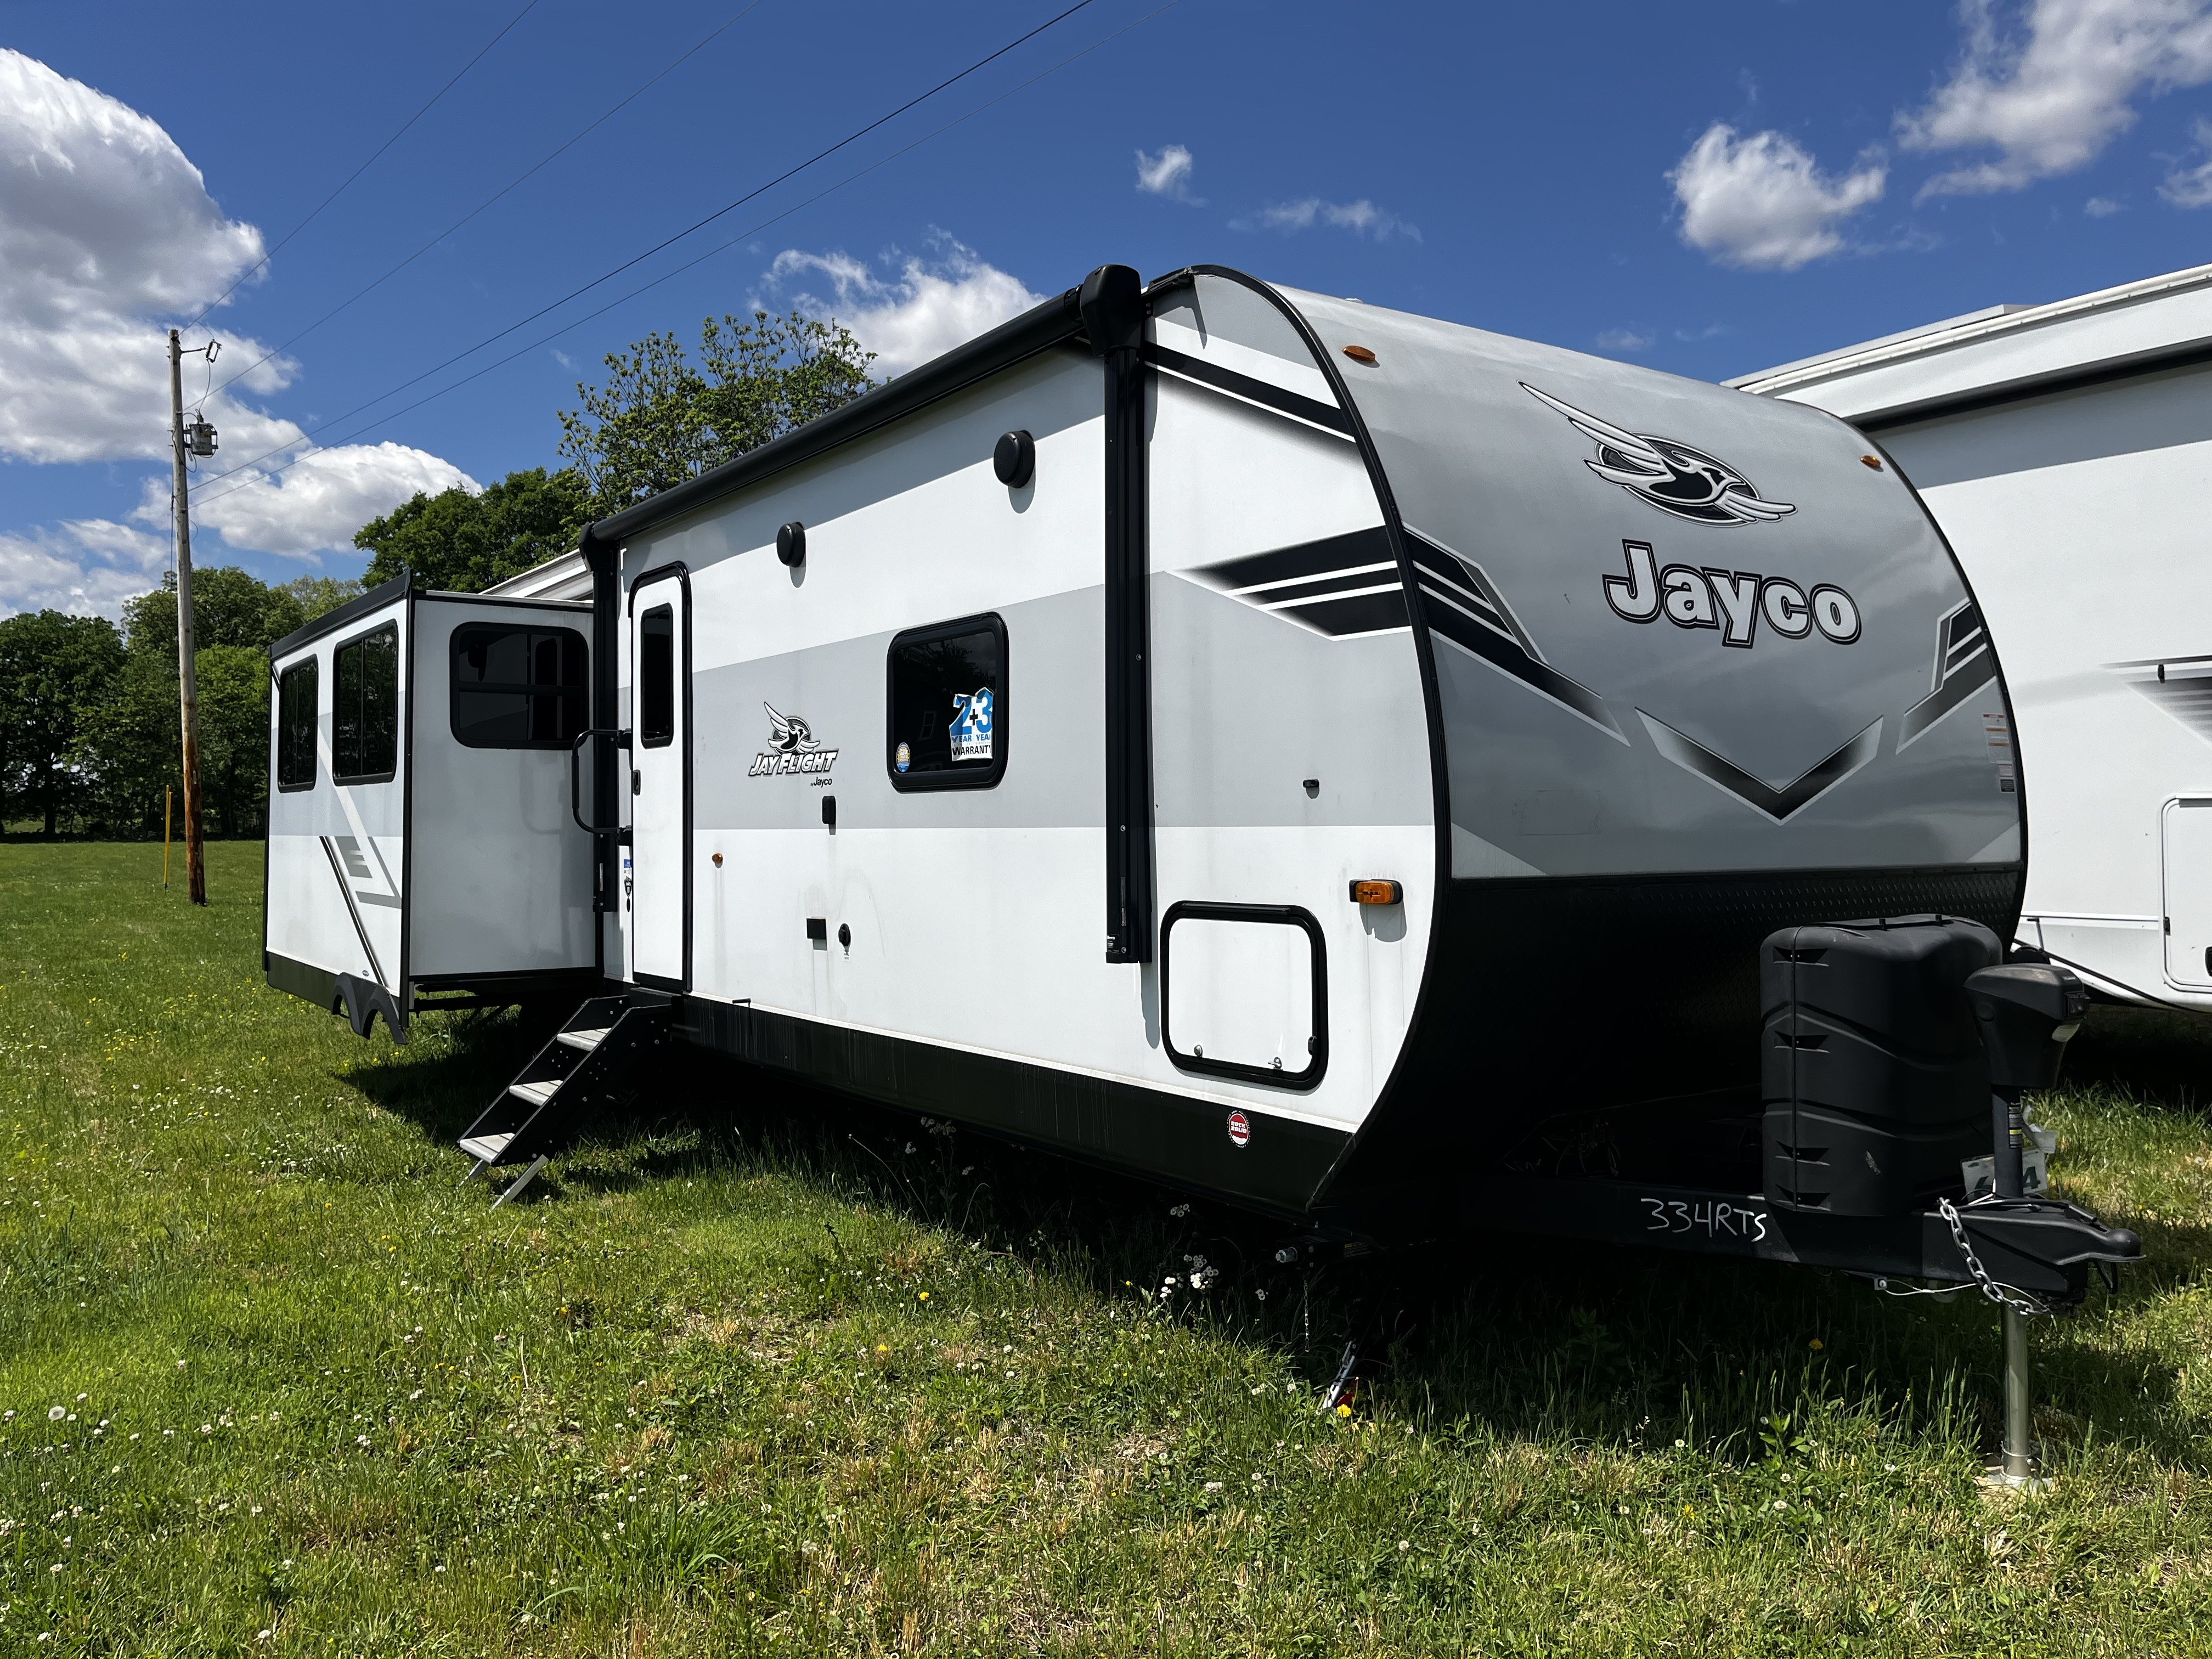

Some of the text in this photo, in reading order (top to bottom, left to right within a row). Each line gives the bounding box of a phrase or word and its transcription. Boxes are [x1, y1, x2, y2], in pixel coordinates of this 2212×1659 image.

[1602, 539, 1862, 649] Jayco
[748, 748, 839, 777] JAY FLIGHT
[814, 777, 832, 788] Jayco
[1641, 1198, 1767, 1242] 334RTS
